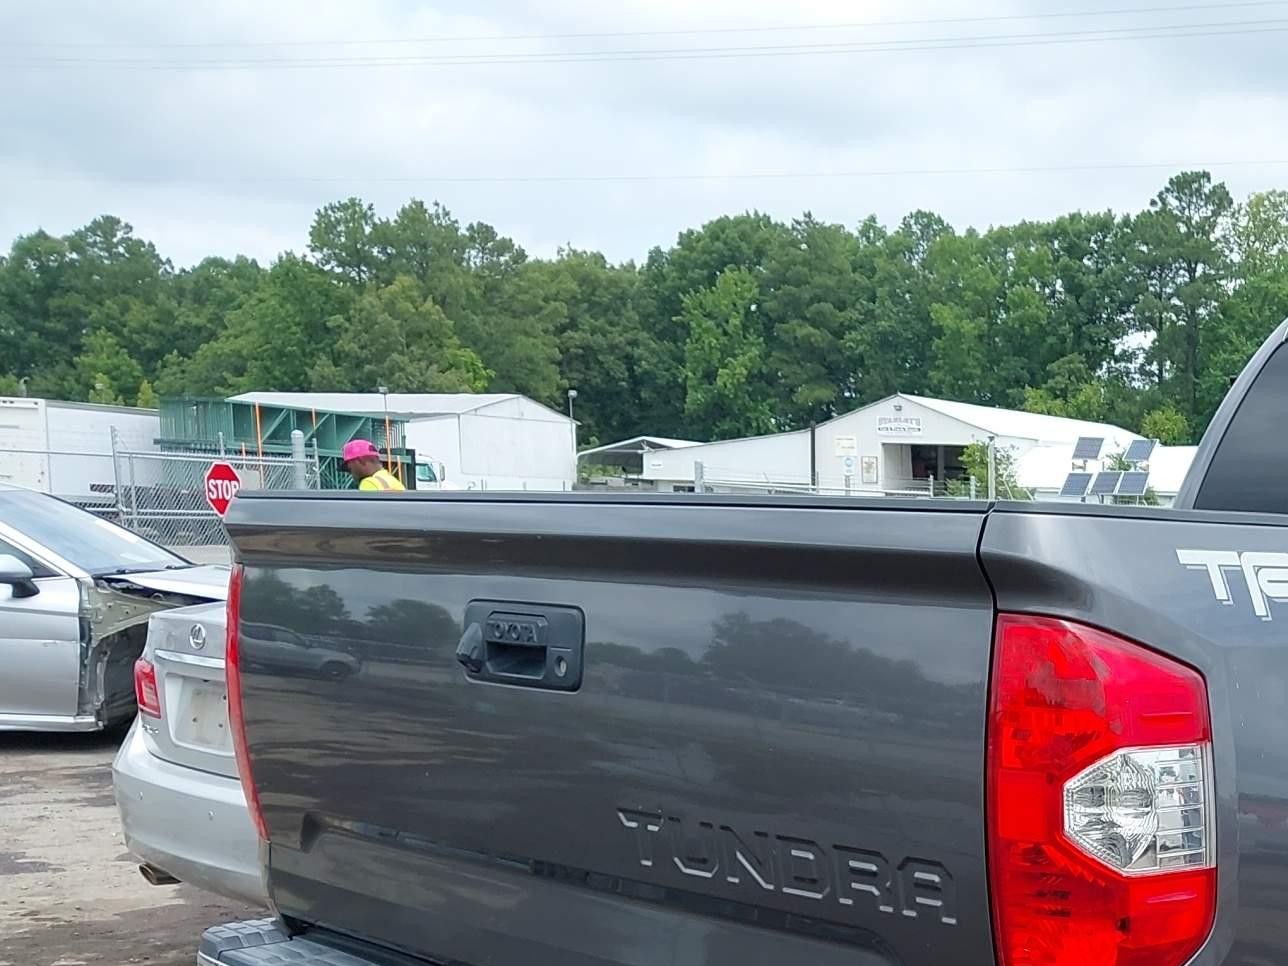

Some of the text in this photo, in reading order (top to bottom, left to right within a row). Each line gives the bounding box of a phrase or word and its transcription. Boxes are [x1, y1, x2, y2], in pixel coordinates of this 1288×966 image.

[208, 479, 239, 501] STOP
[486, 619, 538, 643] TOYOTA
[616, 807, 957, 925] TUNDRA
